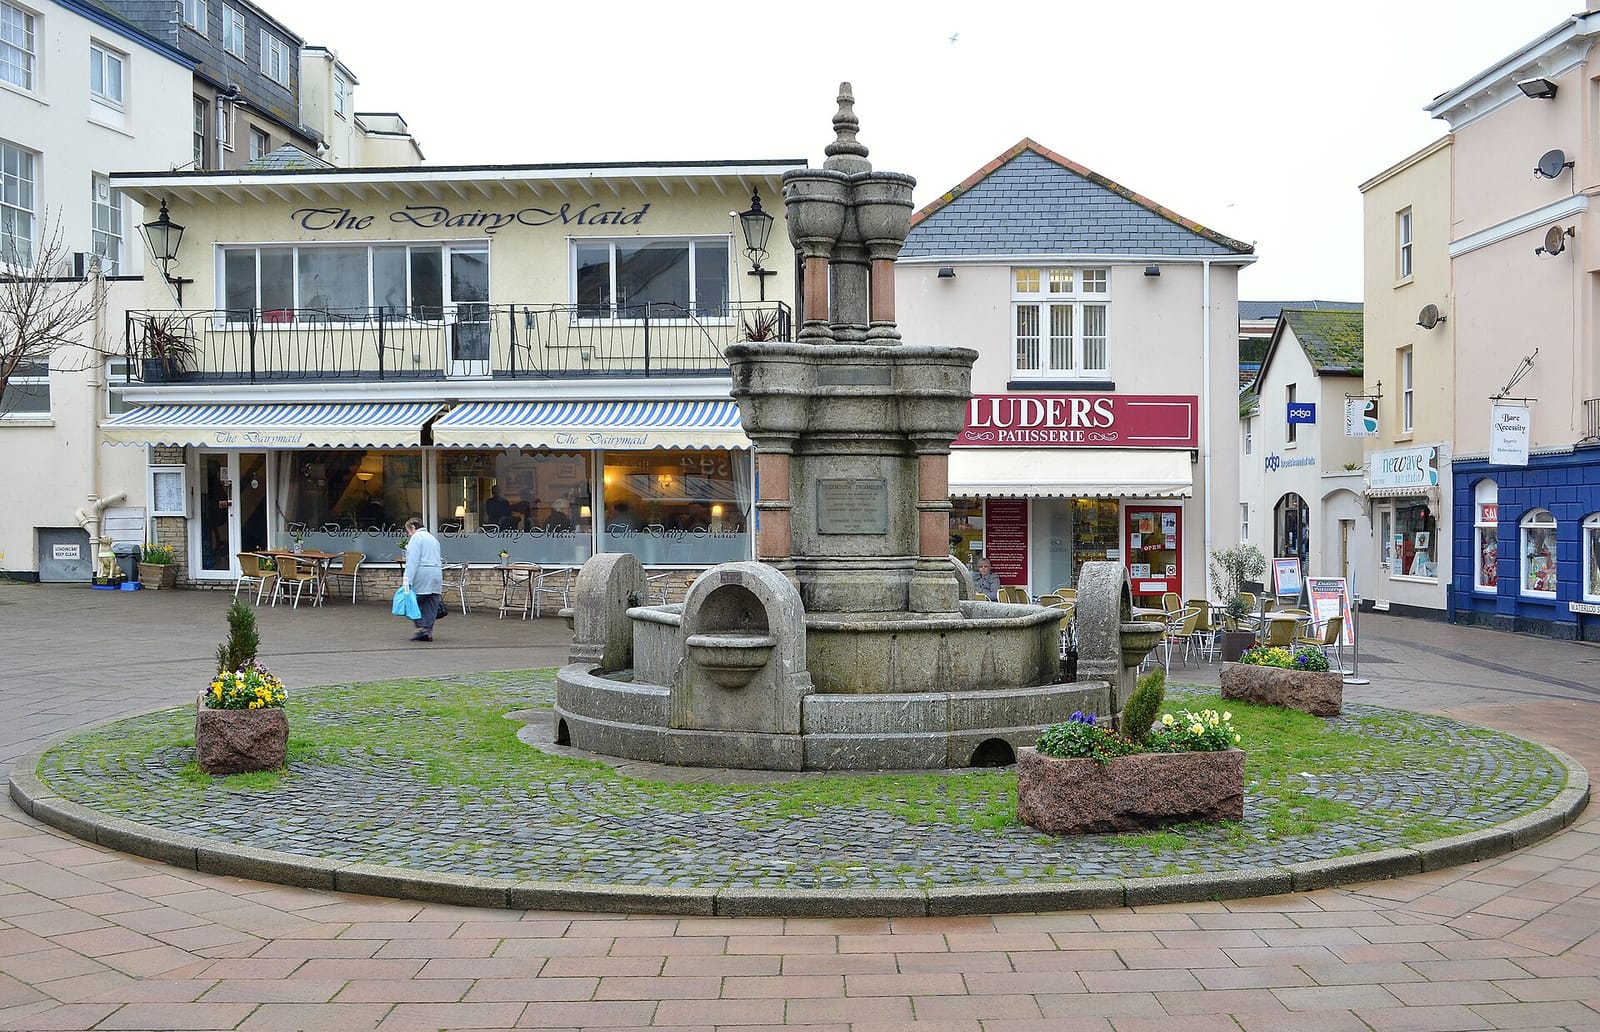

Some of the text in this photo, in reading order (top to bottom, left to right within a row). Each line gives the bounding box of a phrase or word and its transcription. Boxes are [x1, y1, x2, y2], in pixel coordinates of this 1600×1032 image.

[291, 203, 651, 234] The Dairy Maid
[967, 398, 1115, 428] LUDERS
[1290, 407, 1311, 419] pdsa
[1501, 413, 1521, 423] Bare
[214, 431, 303, 445] The Dairymaid
[997, 429, 1086, 442] PATISSERIE
[1495, 422, 1527, 435] Necessity
[554, 432, 649, 448] The Dairymaid
[1264, 451, 1280, 473] pdsa
[1382, 454, 1425, 481] newave
[286, 521, 315, 538] The
[320, 522, 362, 543] Dairy
[439, 522, 470, 539] The
[479, 523, 524, 543] Dairy
[607, 523, 638, 539] The
[643, 523, 688, 543] Dairy
